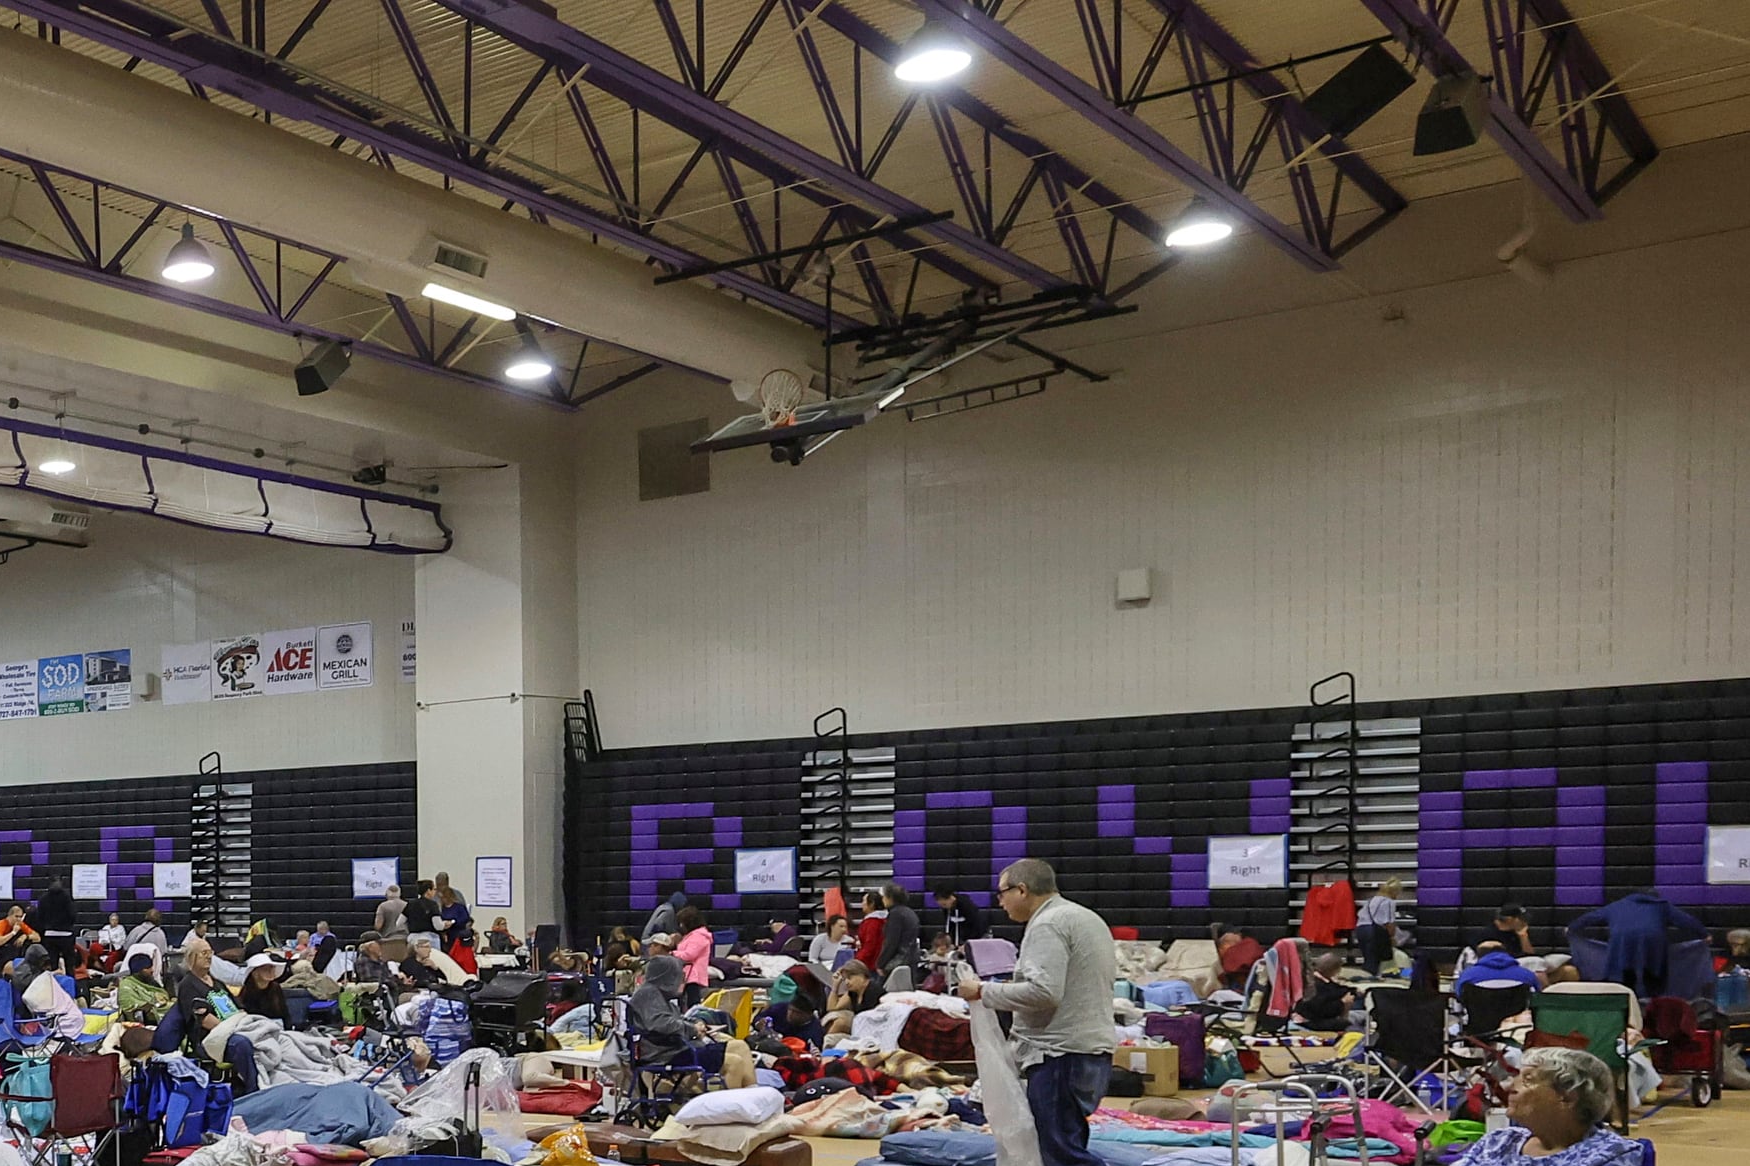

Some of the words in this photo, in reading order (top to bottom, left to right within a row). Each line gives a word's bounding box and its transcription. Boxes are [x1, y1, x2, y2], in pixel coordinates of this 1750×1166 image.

[286, 640, 313, 649] Burkett
[267, 648, 313, 673] ACE
[322, 658, 367, 670] MEXICAN
[42, 663, 79, 688] SOD
[267, 671, 313, 683] Hardware
[331, 670, 358, 680] GRILL
[1242, 848, 1249, 858] 3
[761, 858, 767, 867] 4
[1230, 863, 1261, 877] Right
[752, 873, 775, 883] Right
[165, 881, 180, 890] Right
[366, 880, 382, 889] Right
